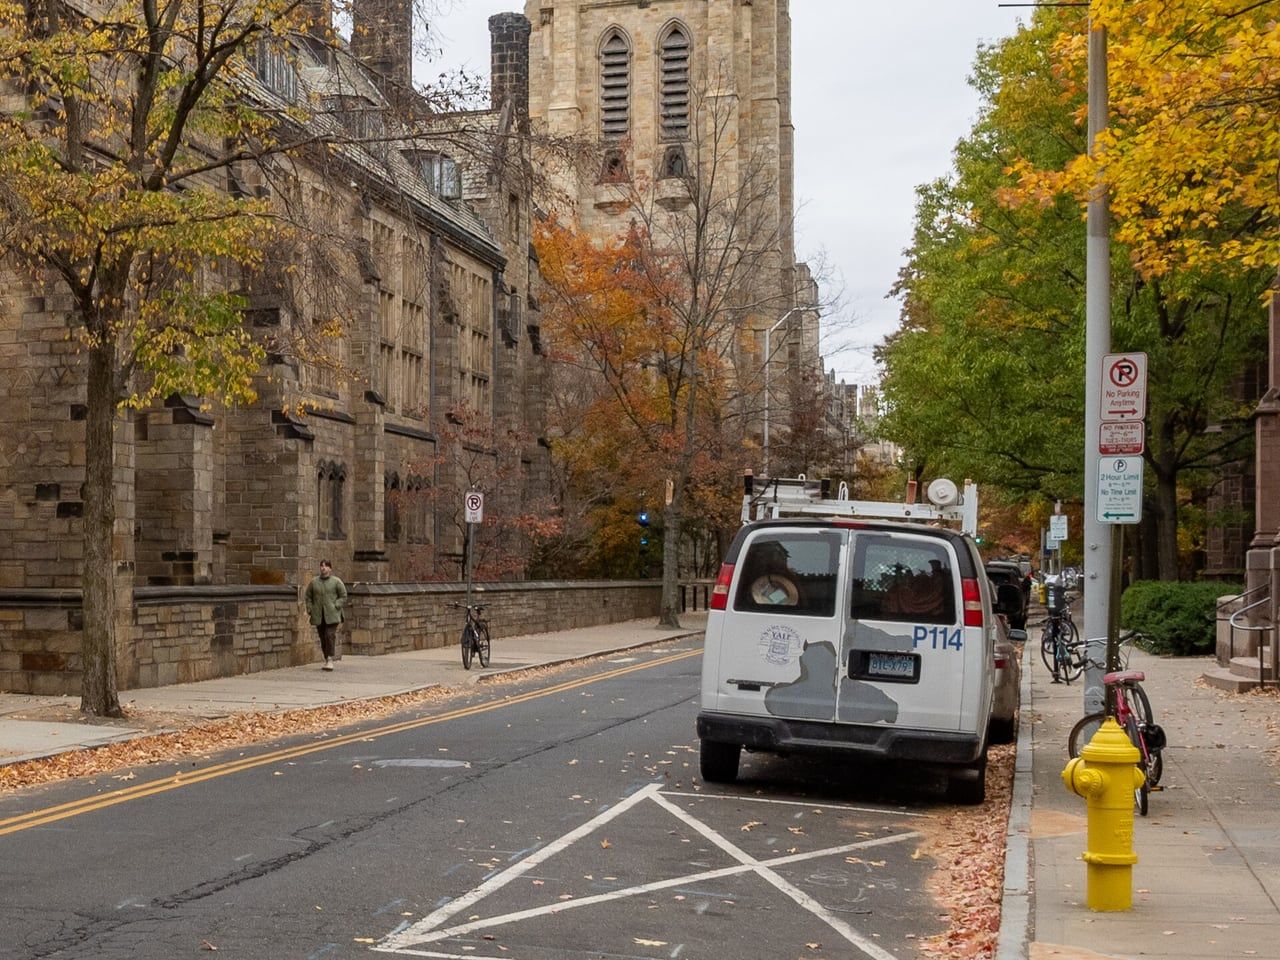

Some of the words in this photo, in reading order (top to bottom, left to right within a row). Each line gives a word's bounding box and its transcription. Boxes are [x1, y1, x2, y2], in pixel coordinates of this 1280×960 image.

[1106, 390, 1115, 398] No
[1117, 390, 1140, 399] Parking
[1101, 473, 1106, 481] 2
[1106, 473, 1121, 481] Hour
[1124, 473, 1139, 481] Limit
[912, 625, 963, 651] P114
